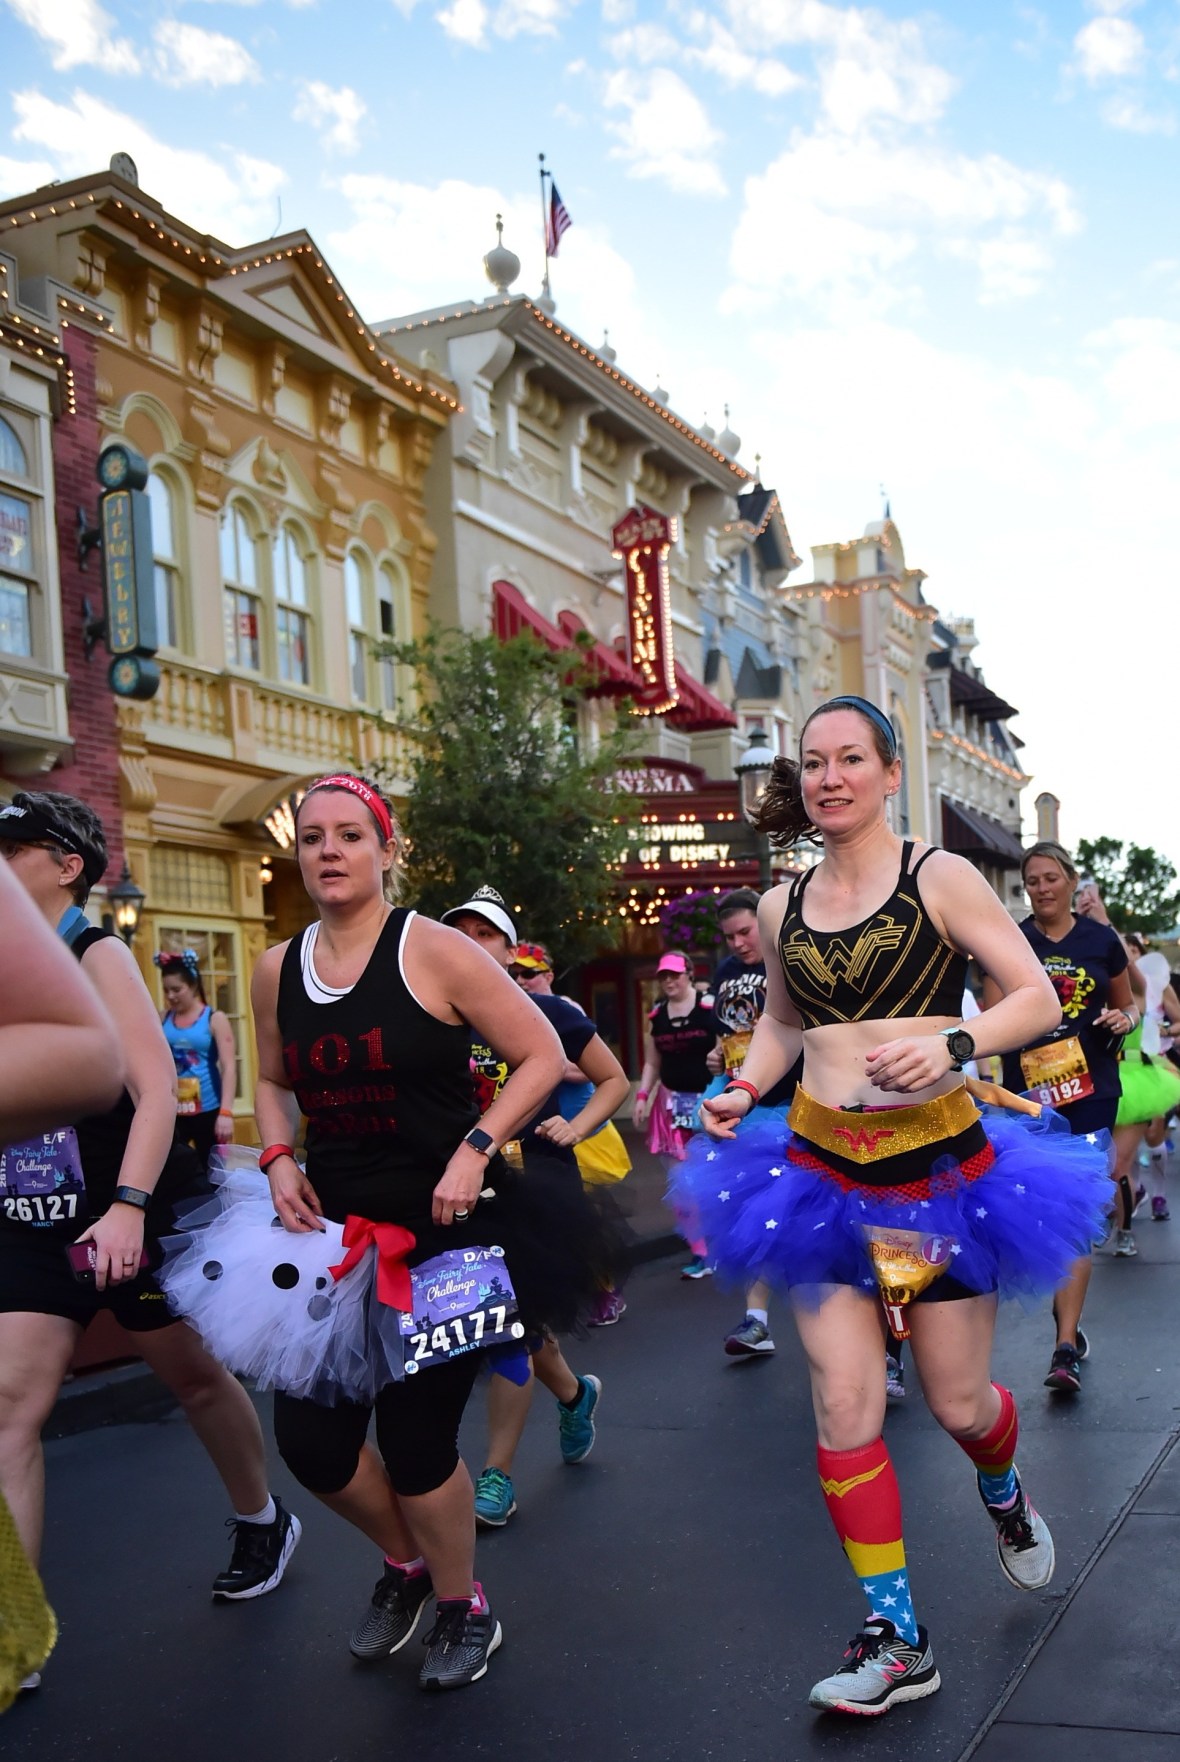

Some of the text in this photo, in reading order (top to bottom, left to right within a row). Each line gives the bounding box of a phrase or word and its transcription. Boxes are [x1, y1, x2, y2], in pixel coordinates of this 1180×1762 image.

[110, 499, 130, 645] JEWELRY
[603, 773, 694, 794] INEMA
[639, 846, 661, 863] OF
[669, 844, 730, 862] DISNEY
[284, 1027, 392, 1082] 101
[1039, 1078, 1084, 1105] 9192
[43, 1132, 66, 1145] E/F
[16, 1159, 53, 1177] Challenge
[3, 1194, 77, 1222] 26127
[463, 1250, 492, 1263] D/F
[867, 1242, 928, 1268] PRINCESS
[437, 1269, 463, 1283] Fairy
[461, 1262, 483, 1274] Tale
[427, 1279, 477, 1302] Challenge
[410, 1305, 507, 1361] 24177
[448, 1341, 481, 1358] ASHLEY
